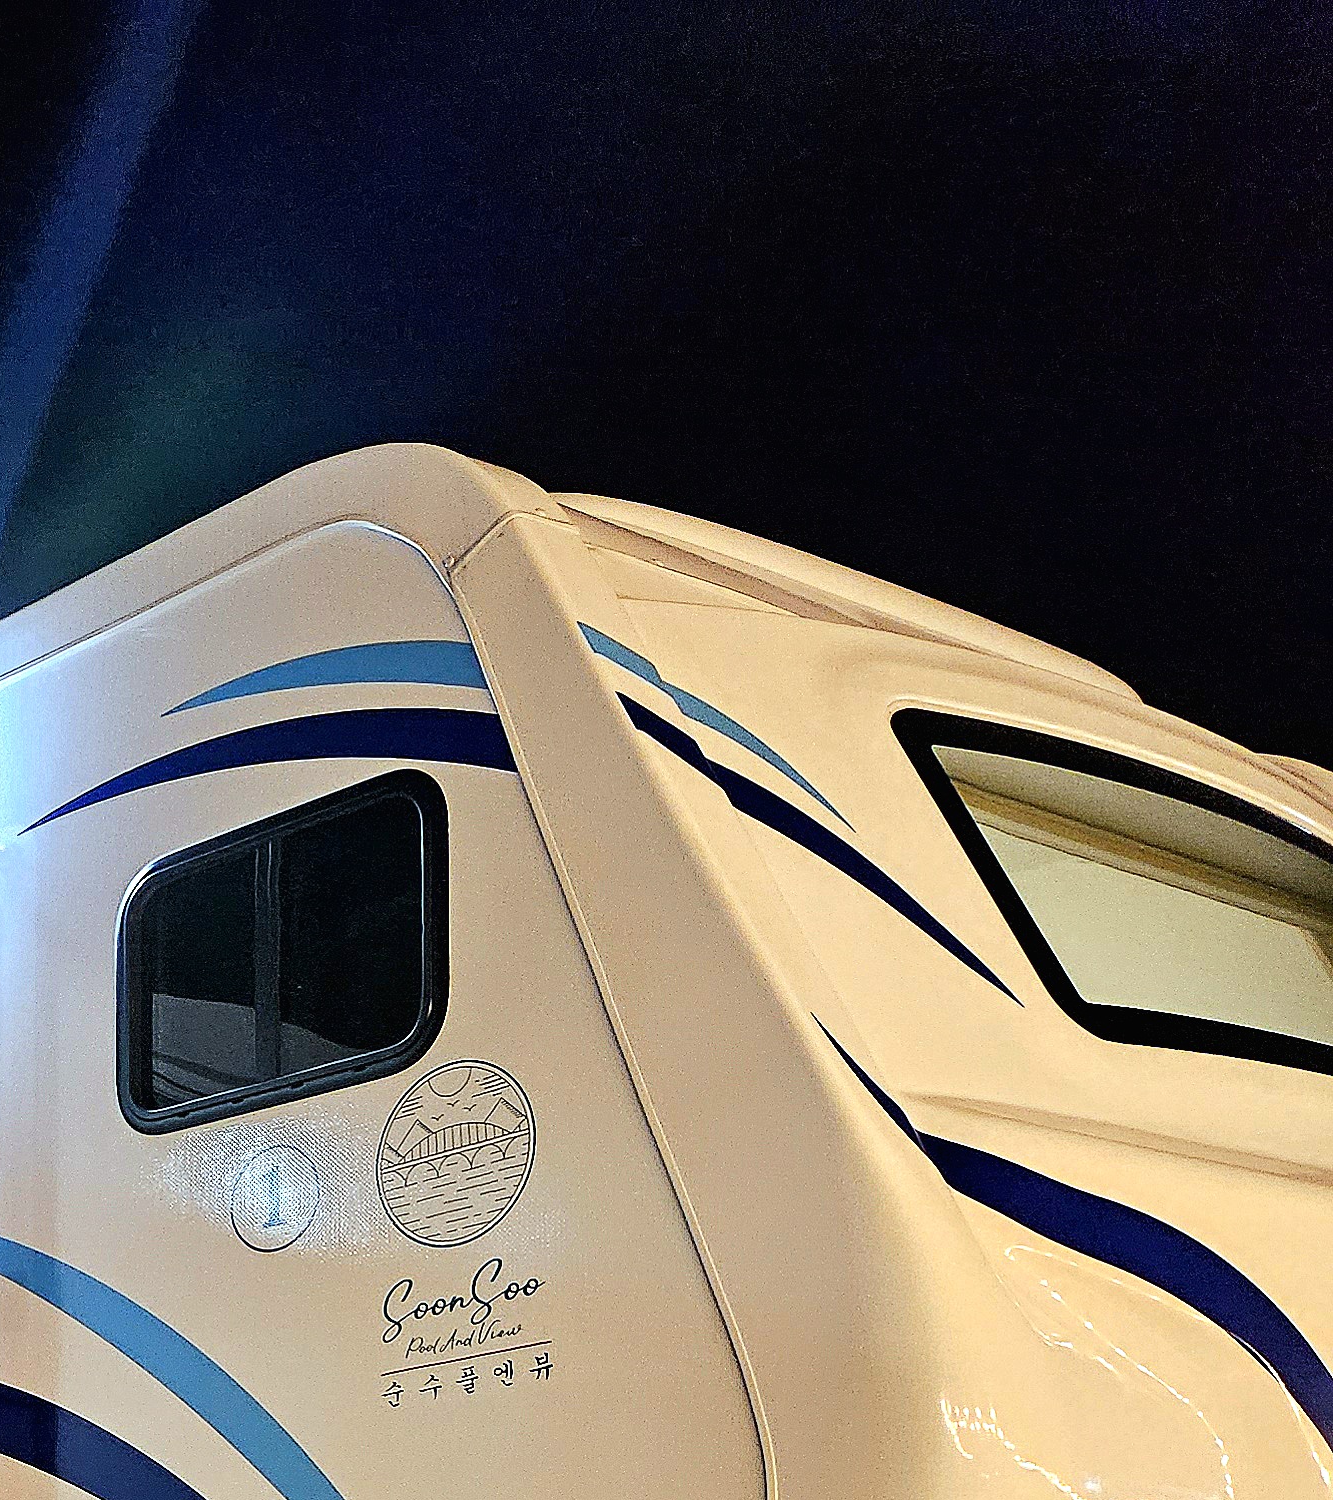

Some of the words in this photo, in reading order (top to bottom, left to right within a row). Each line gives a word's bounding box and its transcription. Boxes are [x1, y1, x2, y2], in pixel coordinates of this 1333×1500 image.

[261, 1165, 288, 1229] 1
[405, 1336, 441, 1359] Pool
[440, 1328, 476, 1354] And
[477, 1319, 524, 1345] View
